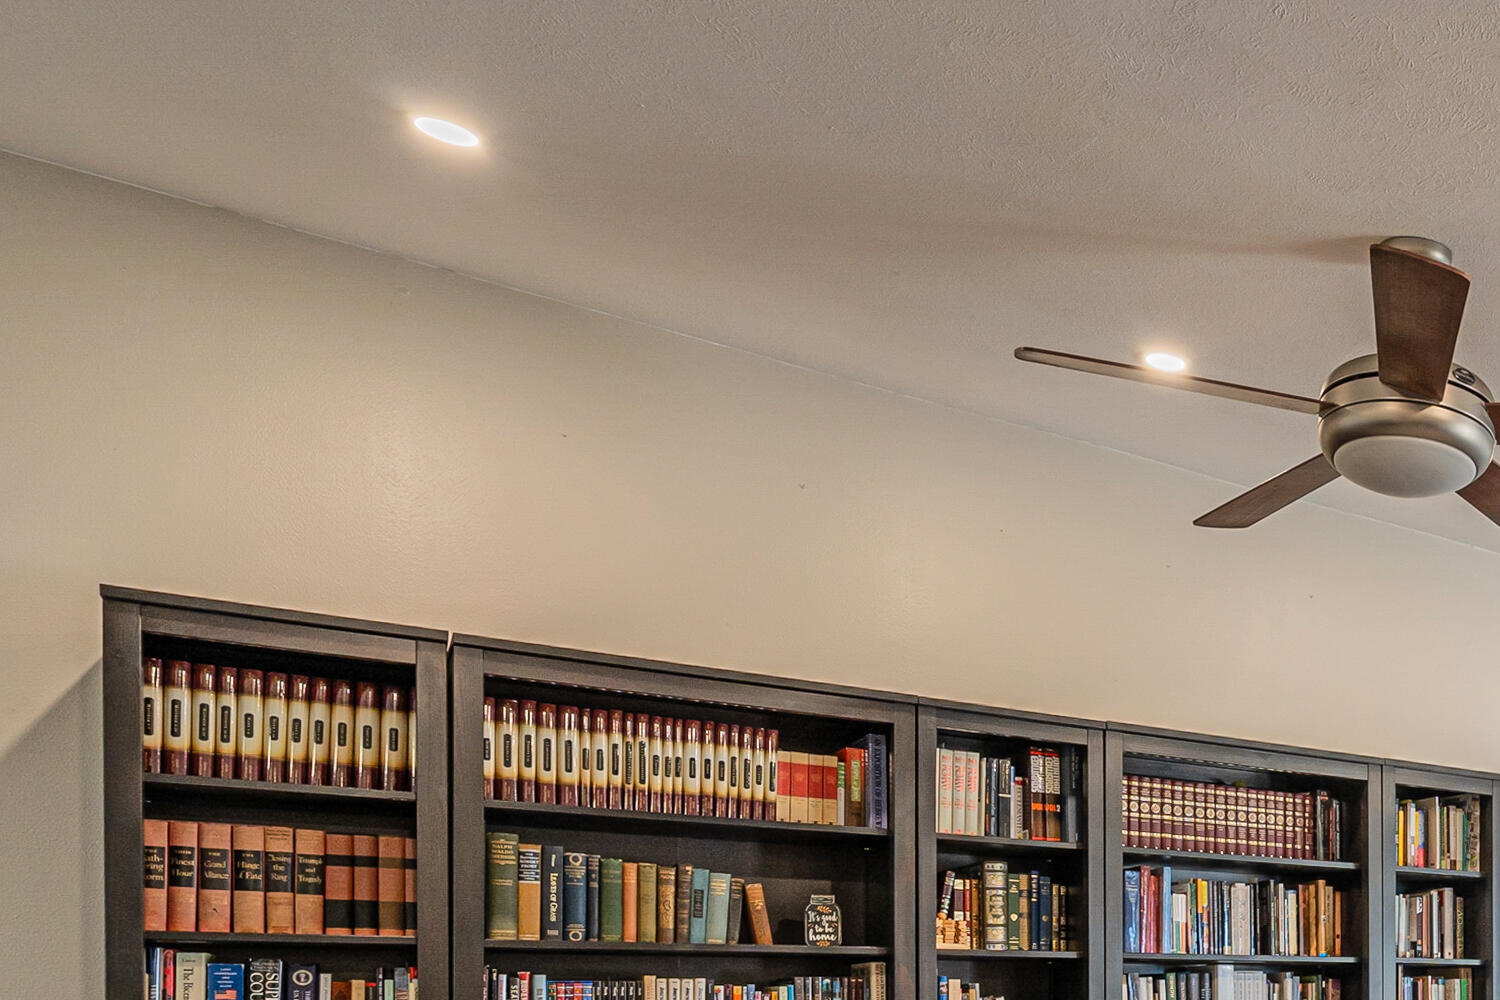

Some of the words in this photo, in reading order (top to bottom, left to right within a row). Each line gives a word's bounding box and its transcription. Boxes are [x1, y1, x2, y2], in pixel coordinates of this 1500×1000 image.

[808, 911, 820, 922] It's
[821, 911, 838, 926] good
[814, 923, 824, 933] to
[825, 923, 834, 933] be
[809, 931, 838, 942] home
[183, 968, 194, 981] The
